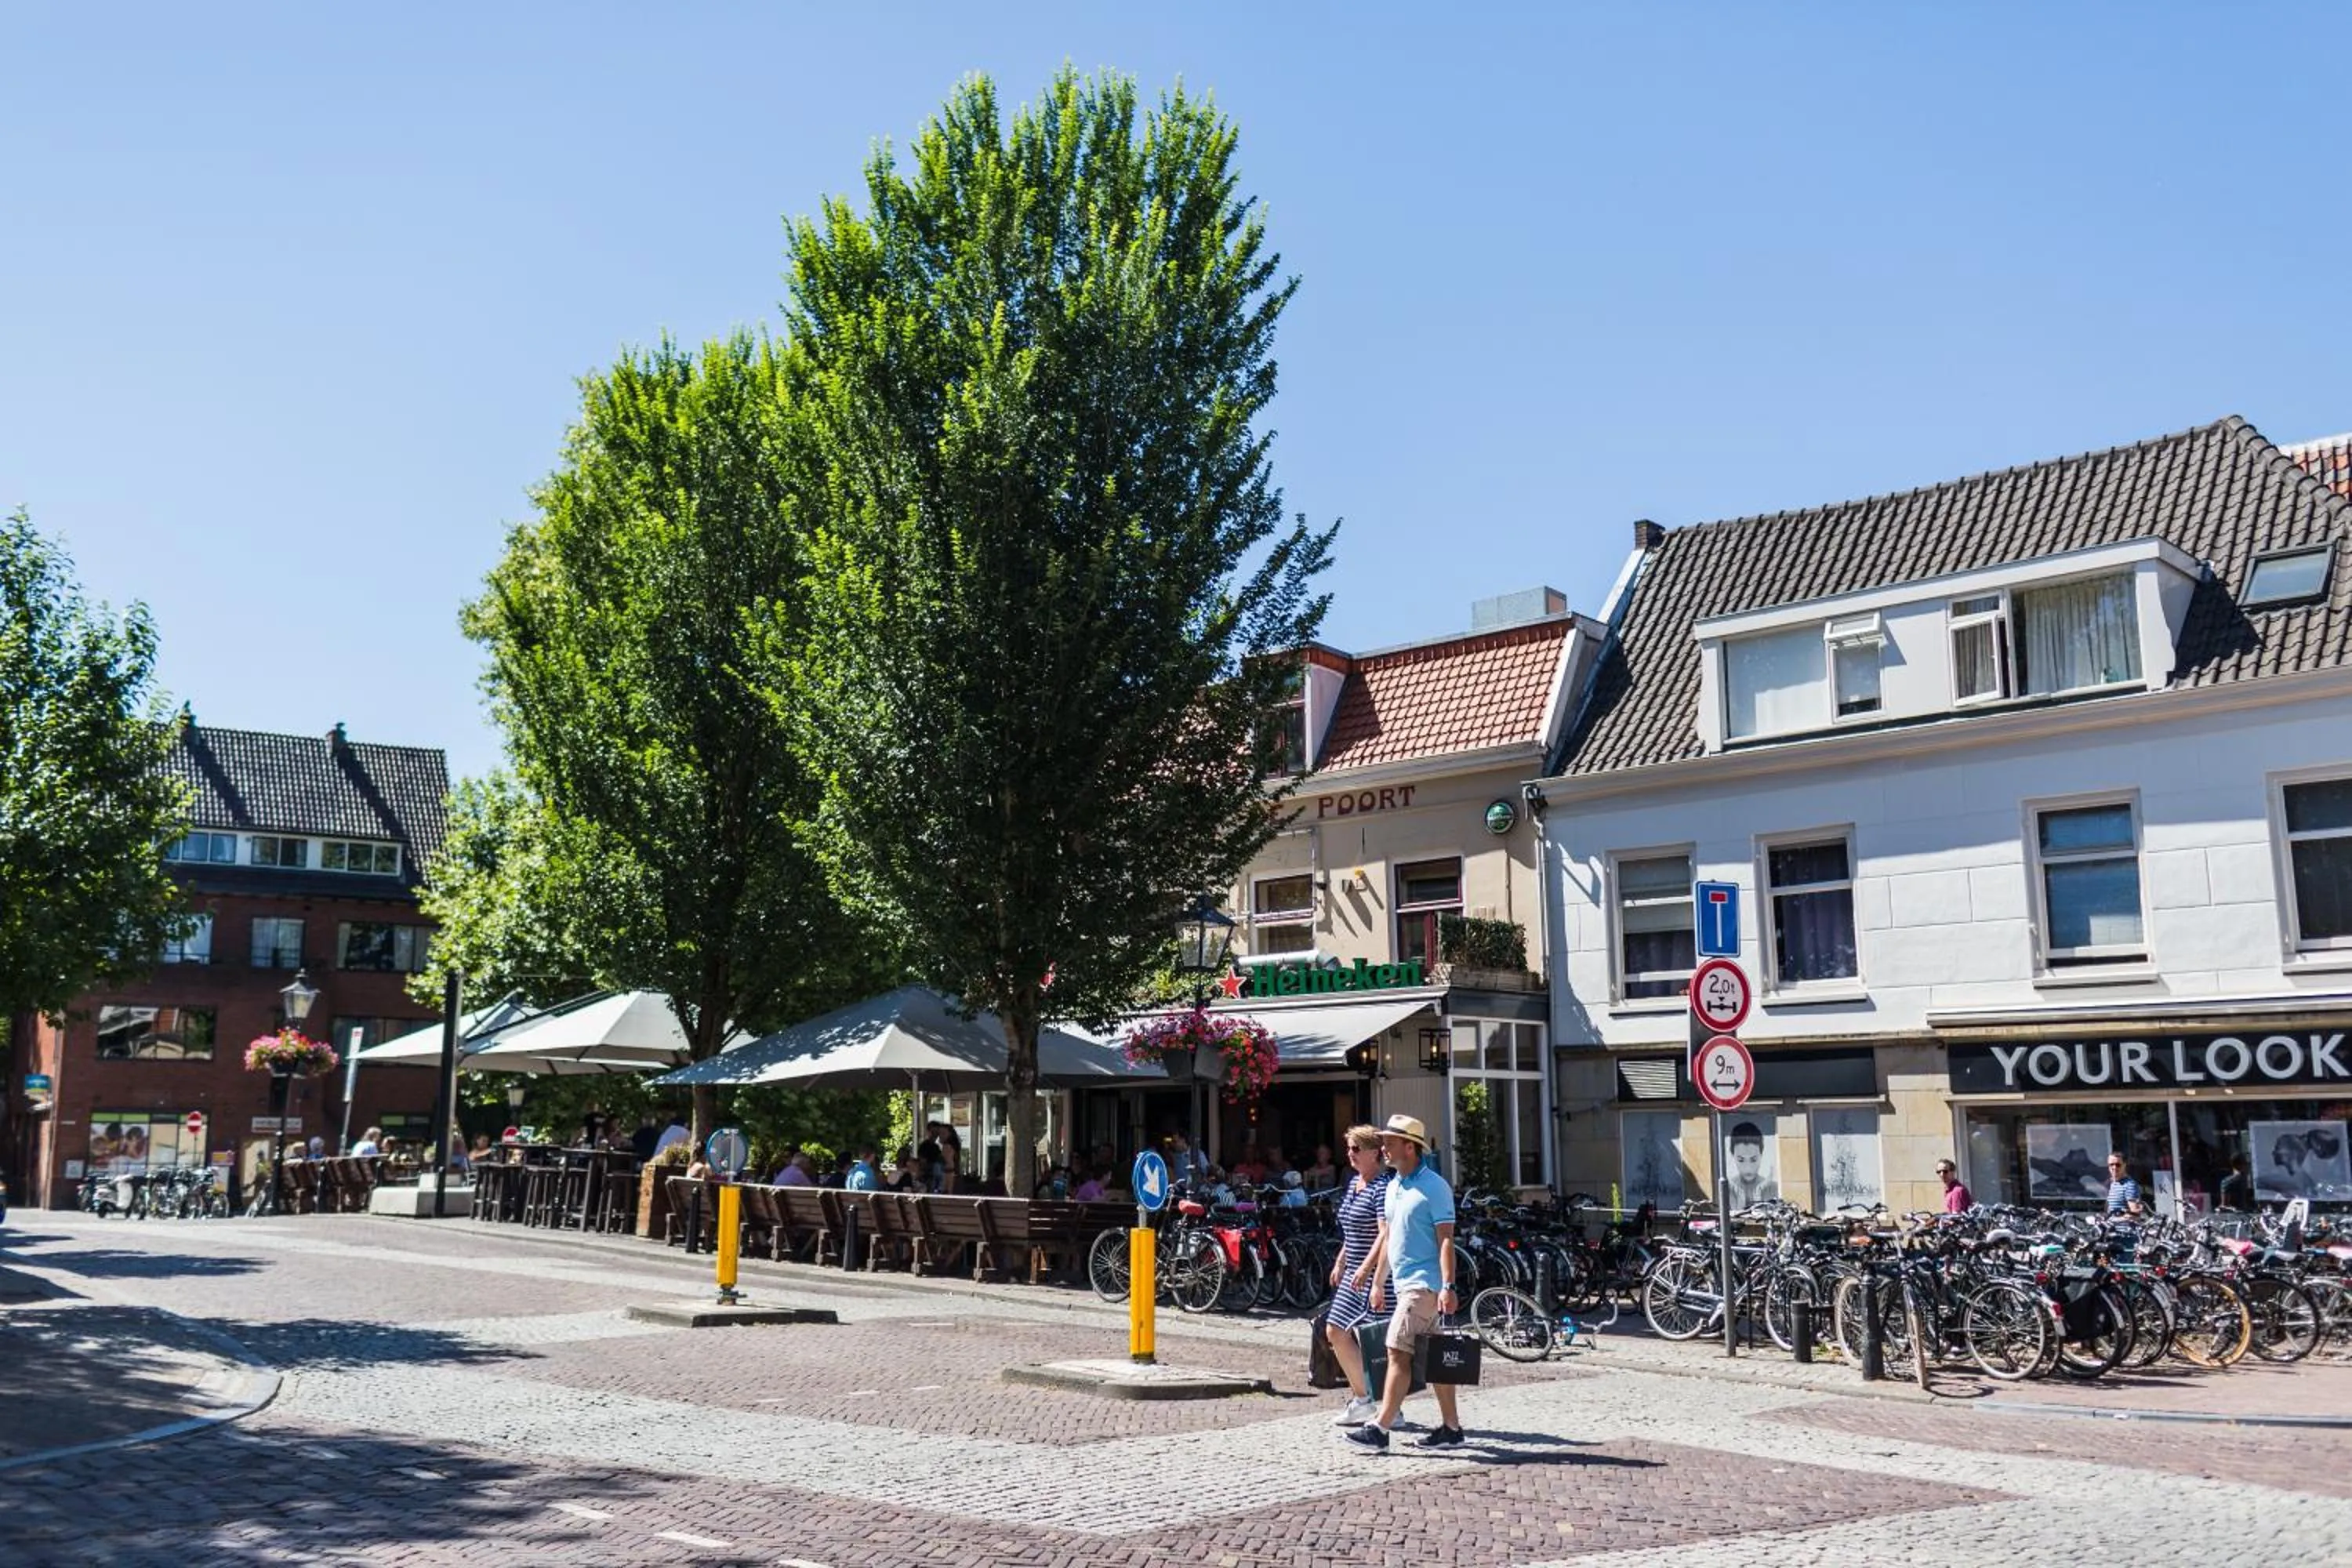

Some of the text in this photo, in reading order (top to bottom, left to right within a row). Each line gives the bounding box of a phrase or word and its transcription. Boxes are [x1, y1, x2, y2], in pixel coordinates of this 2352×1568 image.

[1317, 786, 1415, 818] POORT
[1252, 958, 1421, 996] Heineken
[1991, 1034, 2352, 1086] YOUR LOOK
